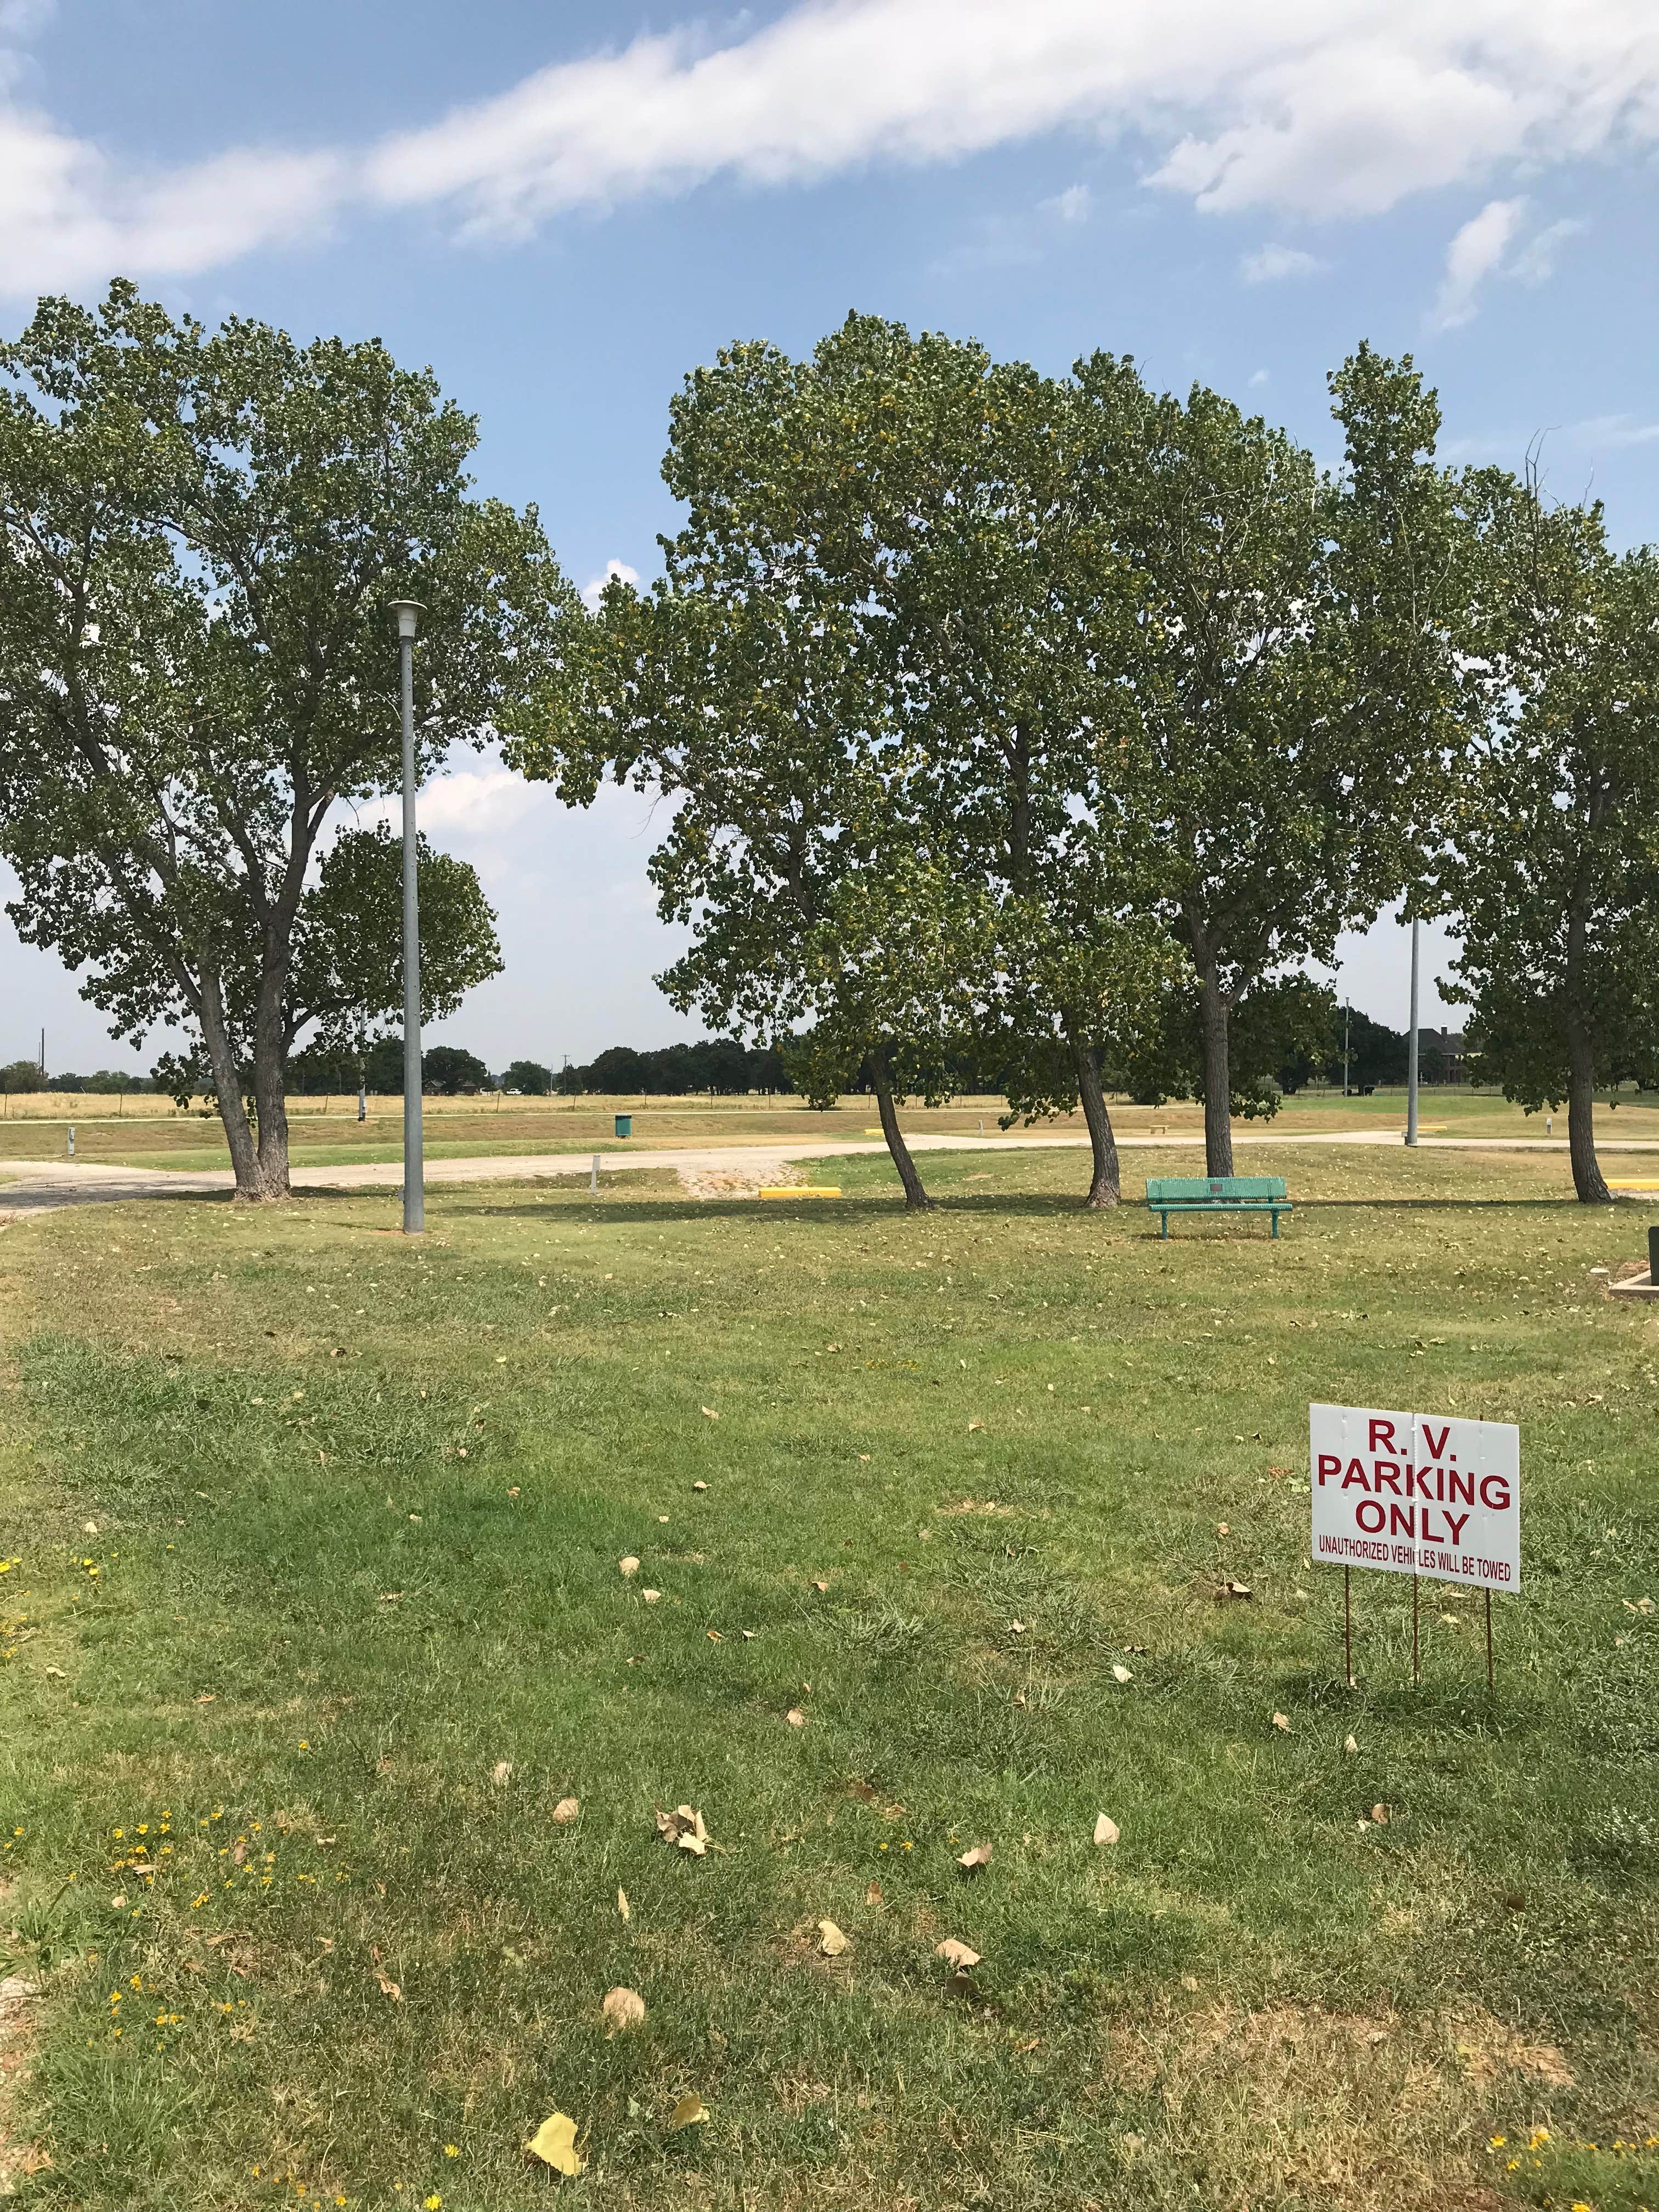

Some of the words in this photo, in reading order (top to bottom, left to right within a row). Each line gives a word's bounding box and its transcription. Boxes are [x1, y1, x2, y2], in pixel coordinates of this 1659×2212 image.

[1369, 1419, 1407, 1455] R.
[1422, 1425, 1457, 1462] V.
[1318, 1454, 1510, 1510] PARKING
[1356, 1500, 1470, 1545] ONLY
[1319, 1535, 1389, 1561] UNAUTHORIZED
[1438, 1551, 1460, 1573] WILL
[1462, 1556, 1475, 1576] BE
[1477, 1559, 1511, 1582] TOWED
